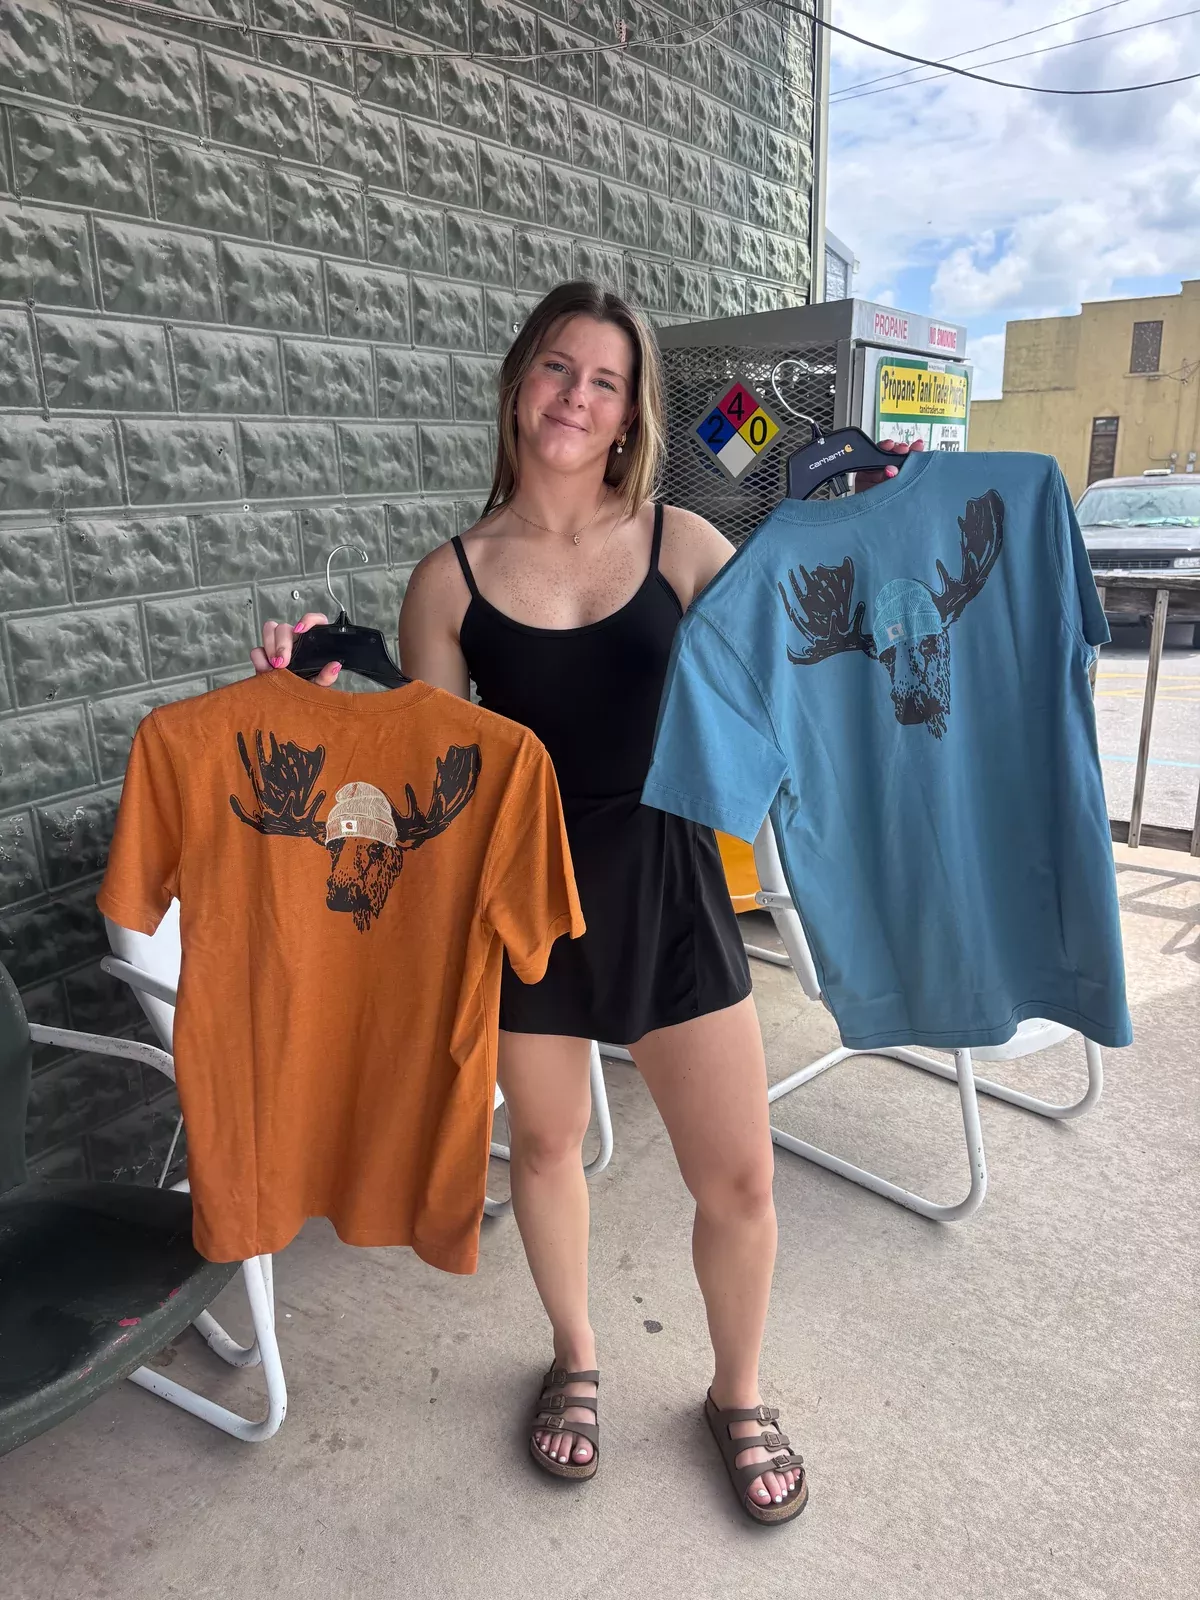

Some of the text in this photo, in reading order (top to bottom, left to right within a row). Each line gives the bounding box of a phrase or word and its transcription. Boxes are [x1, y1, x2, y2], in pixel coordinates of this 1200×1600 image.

[874, 313, 908, 340] PROPANE
[929, 326, 957, 349] NO SMOKING
[883, 370, 916, 408] Propane
[917, 374, 932, 403] Tank
[727, 392, 745, 421] 4
[707, 415, 725, 443] 2
[749, 416, 768, 446] 0
[808, 449, 846, 470] carhartt
